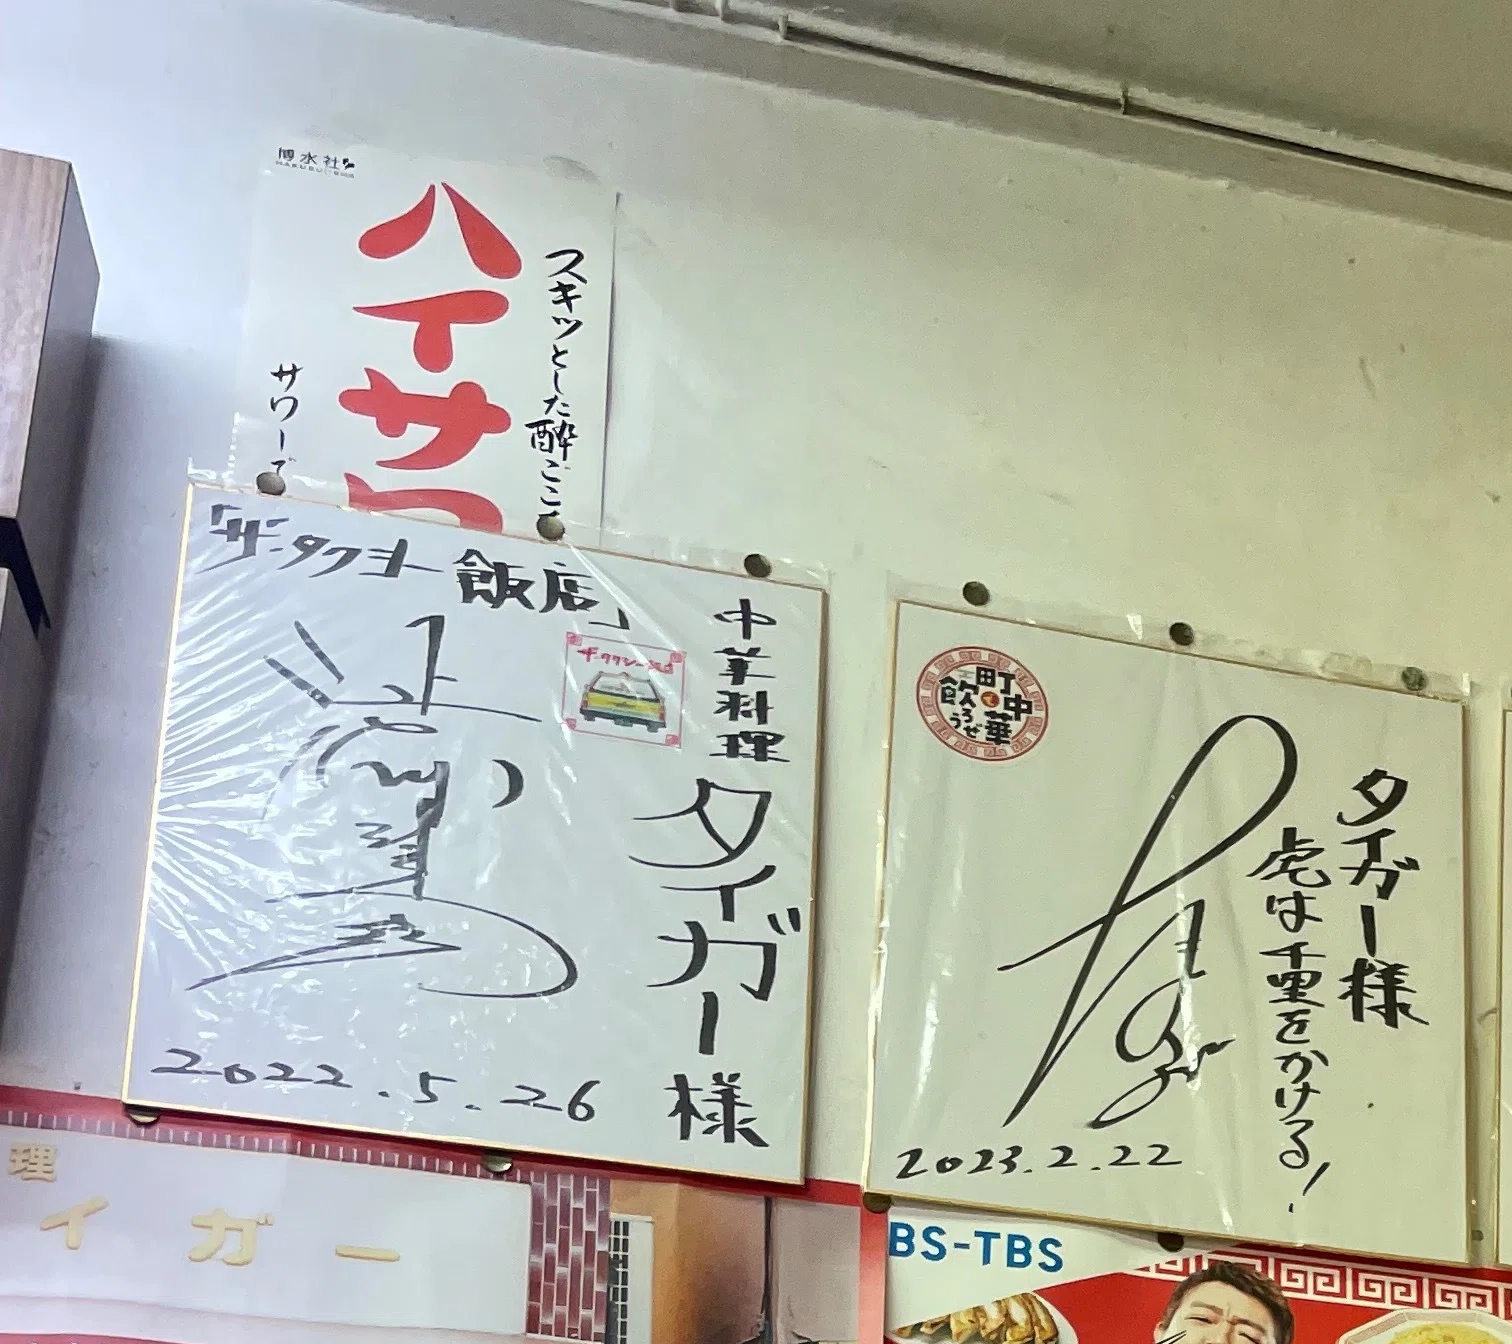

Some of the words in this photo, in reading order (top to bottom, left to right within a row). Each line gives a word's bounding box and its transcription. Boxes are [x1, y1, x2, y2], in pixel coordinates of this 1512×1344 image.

[525, 247, 588, 517] スキッとした酔ごこ
[1337, 768, 1430, 1030] タイガー様
[150, 1048, 600, 1122] 2022.5.26
[895, 1142, 1183, 1180] 2023.2.22
[888, 1221, 1065, 1274] BS-TBS
